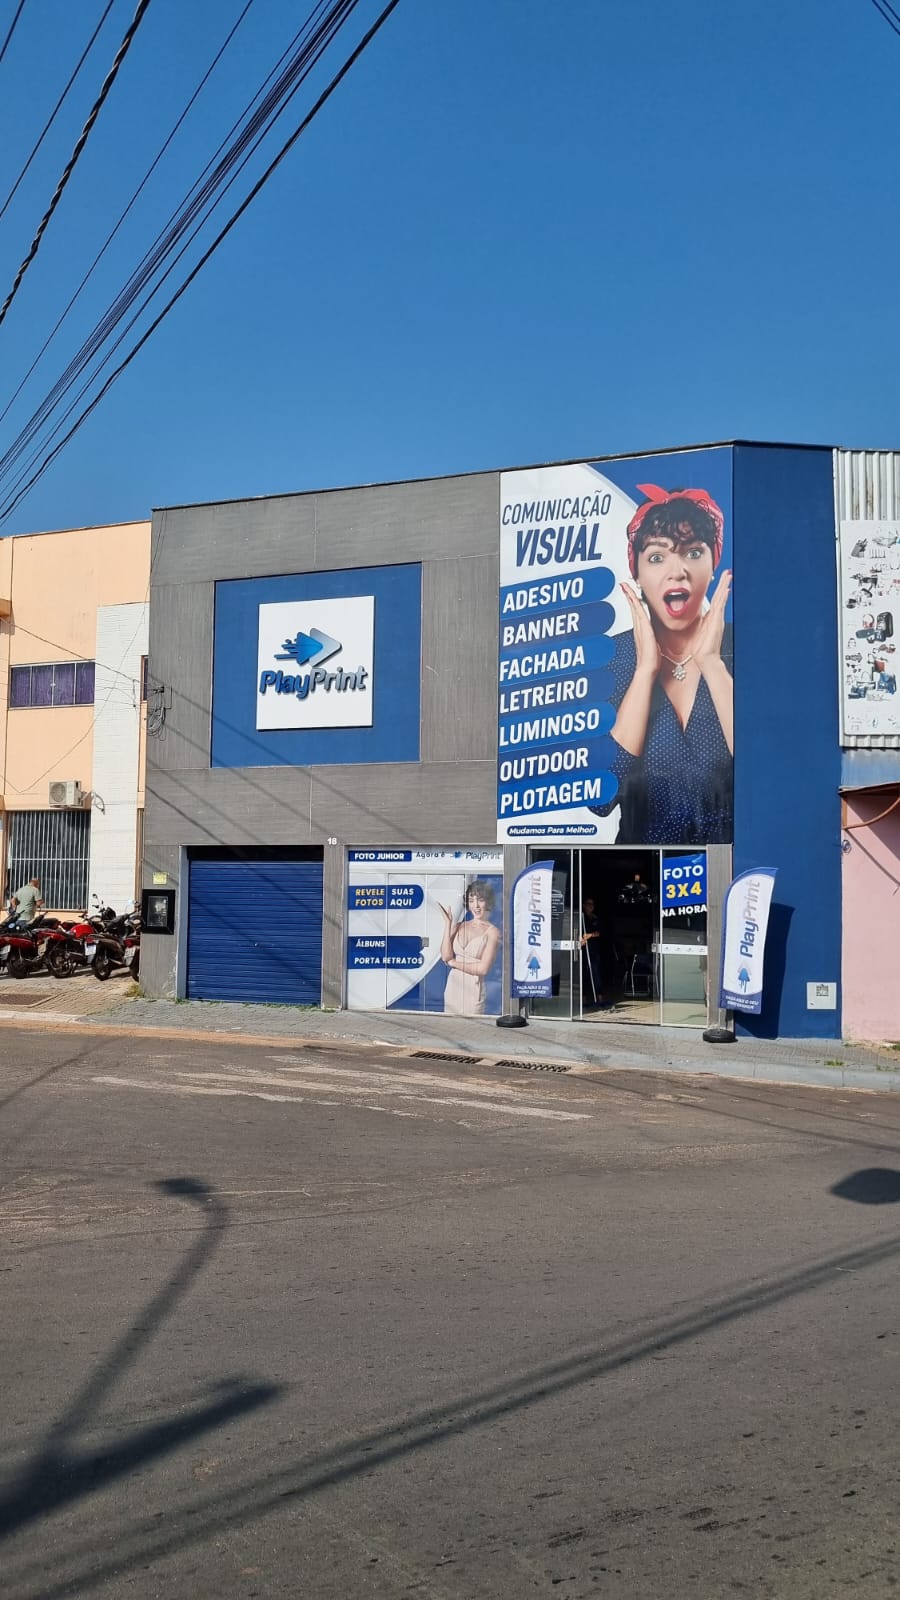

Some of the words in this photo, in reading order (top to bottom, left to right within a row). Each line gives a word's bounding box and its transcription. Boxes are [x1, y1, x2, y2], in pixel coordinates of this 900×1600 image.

[502, 490, 612, 525] COMUNICAÇÃO
[516, 523, 602, 567] VISUAL
[502, 577, 584, 613] ADESIVO
[502, 612, 580, 647] BANNER
[500, 646, 585, 682] FACHADA
[260, 665, 368, 701] PlayPrint
[500, 677, 588, 714] LETREIRO
[500, 708, 600, 747] LUMINOSO
[500, 747, 589, 782] OUTDOOR
[501, 778, 601, 814] PLOTAGEM
[327, 837, 337, 845] 18
[509, 827, 546, 835] Mudamos
[566, 826, 596, 834] Melhor!
[354, 852, 374, 860] FOTO
[377, 852, 405, 860] JUNIOR
[663, 865, 704, 880] FOTO
[355, 888, 385, 896] REVELE
[391, 888, 414, 896] SUAS
[355, 898, 384, 906] FOTOS
[390, 898, 412, 907] AQUI
[666, 881, 702, 899] 3X4
[528, 875, 545, 947] PlayPrint
[660, 908, 676, 918] NA
[678, 904, 707, 916] HORA
[739, 879, 761, 958] PlayPrint
[356, 938, 386, 948] ÁLBUNS
[354, 957, 380, 965] PORTA
[382, 957, 423, 965] RETRATOS
